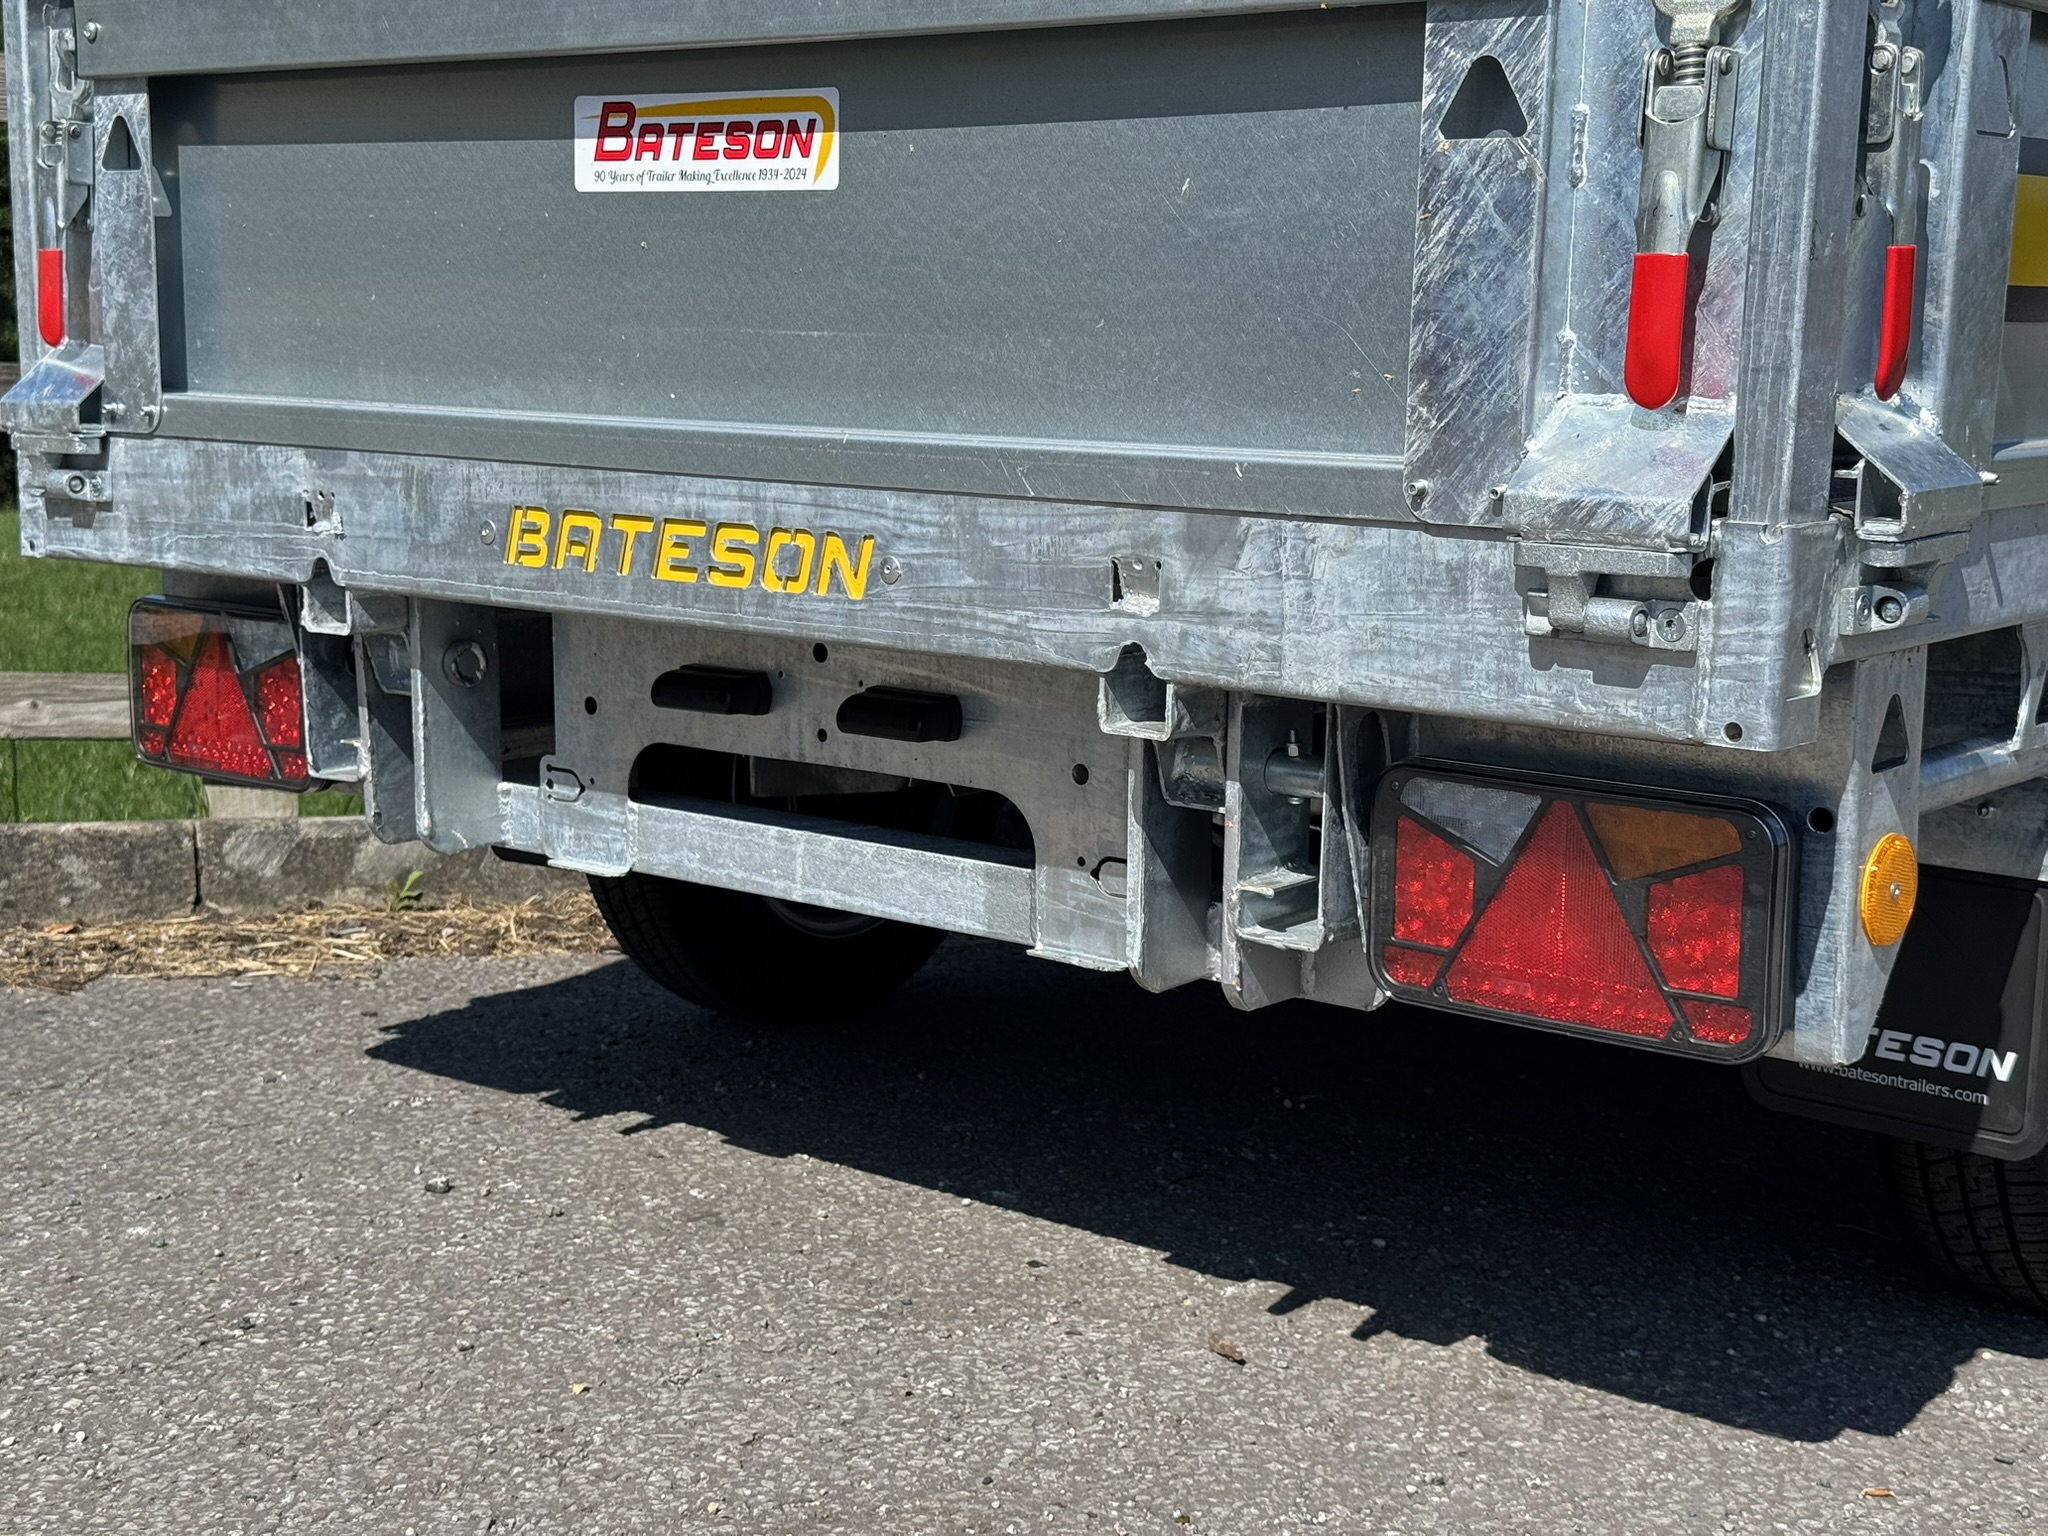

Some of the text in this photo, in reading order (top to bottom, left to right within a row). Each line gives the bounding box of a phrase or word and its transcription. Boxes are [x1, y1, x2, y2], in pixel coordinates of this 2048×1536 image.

[593, 100, 817, 162] BATESON
[593, 167, 808, 186] 90 Years of Trailer Making Excellence 1934-2024
[502, 504, 876, 602] BATESON
